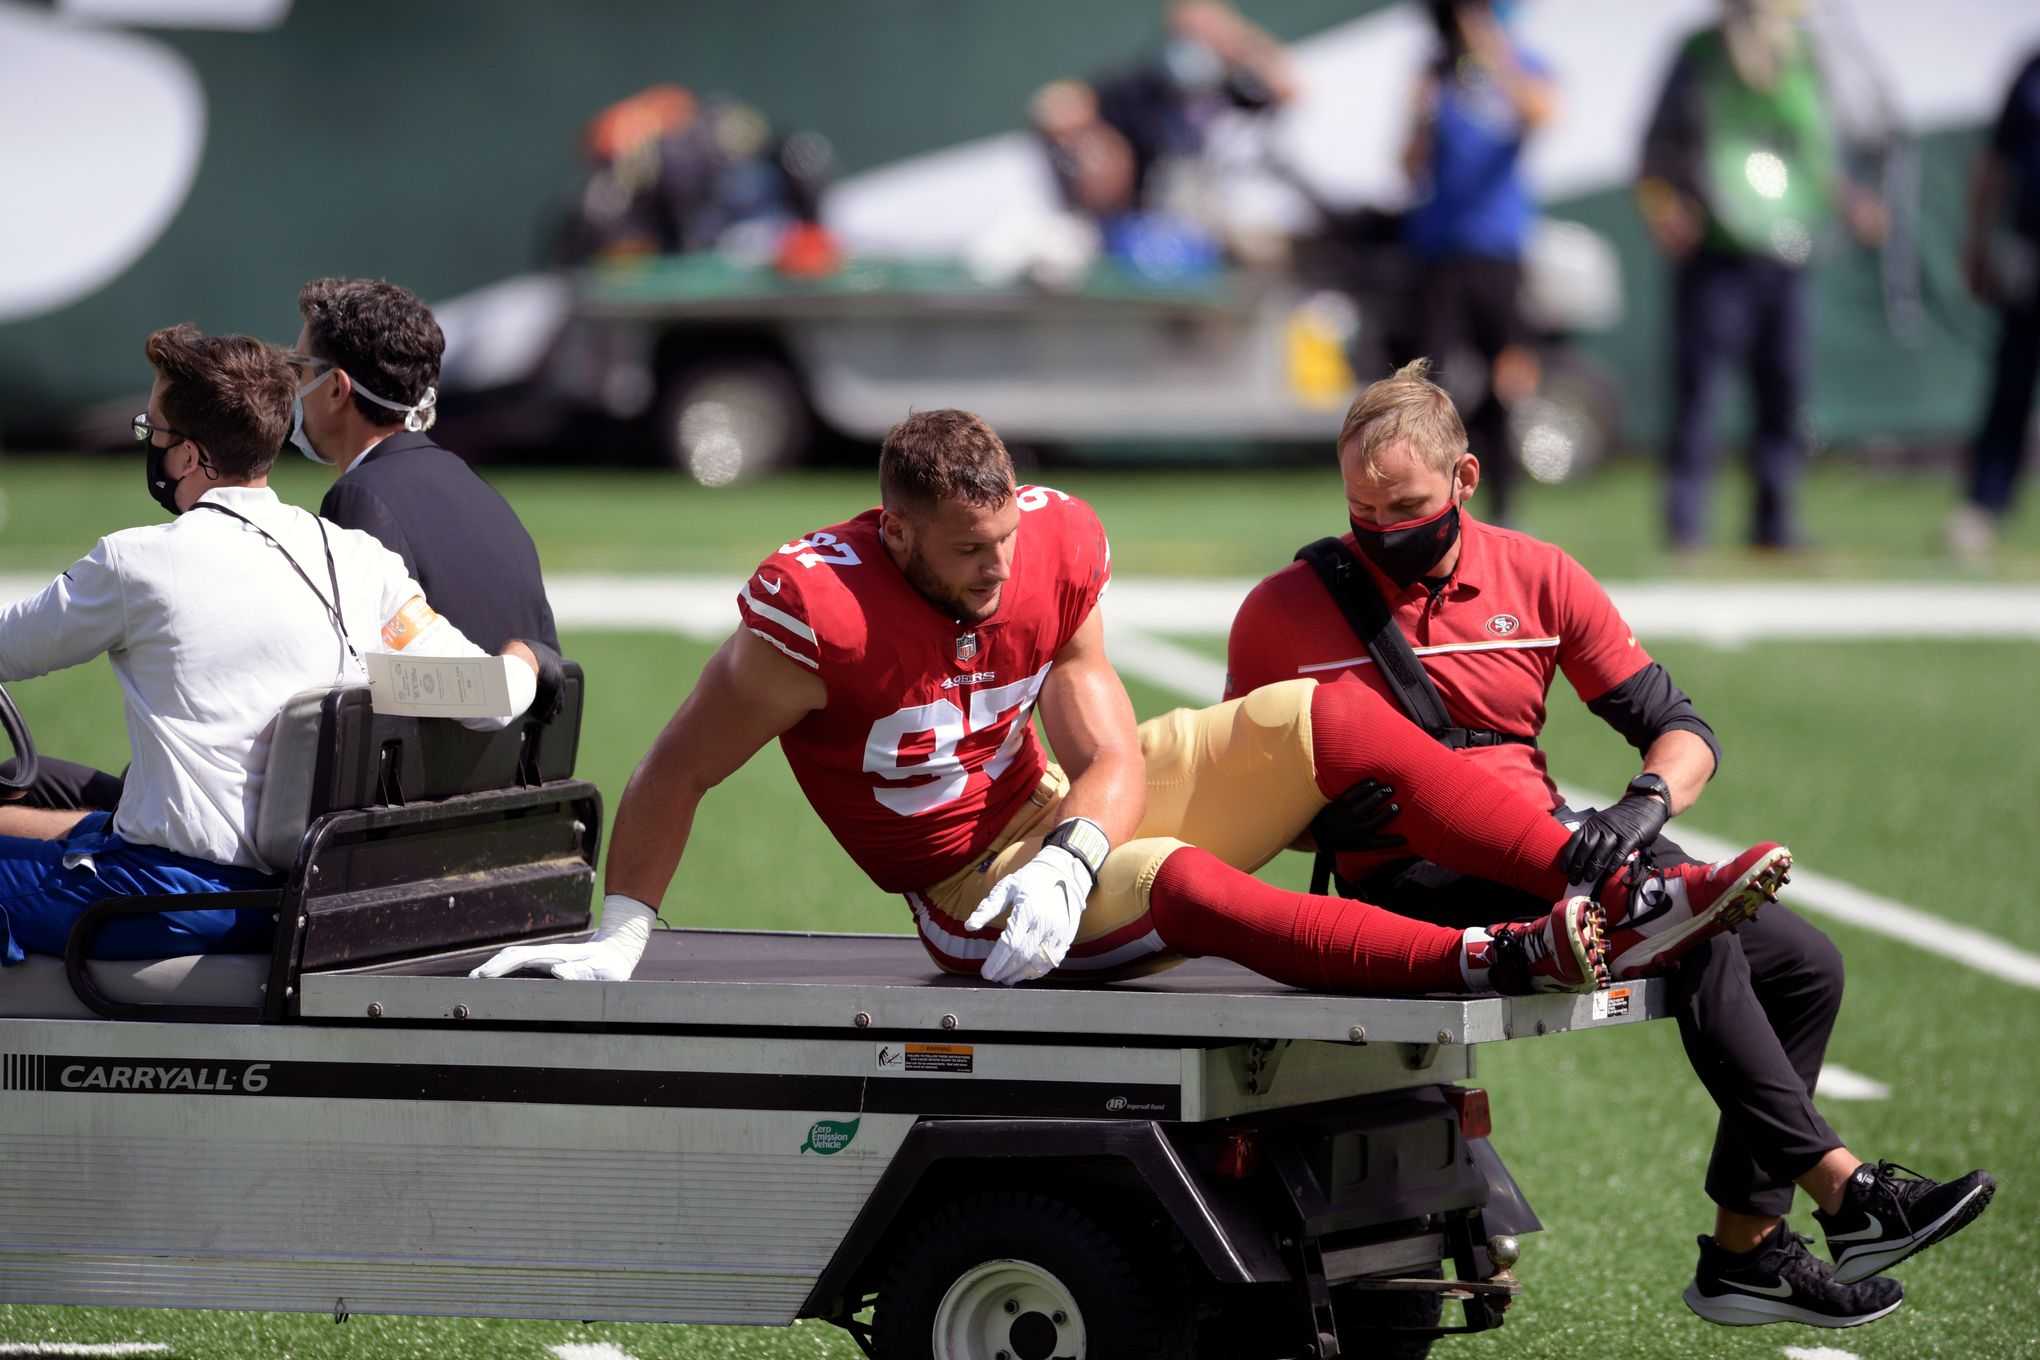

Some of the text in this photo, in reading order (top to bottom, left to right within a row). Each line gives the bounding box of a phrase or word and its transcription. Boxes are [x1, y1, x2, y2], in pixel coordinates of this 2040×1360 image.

[778, 532, 863, 569] 97
[940, 671, 996, 690] 49ERS
[863, 660, 1055, 817] 97
[60, 1063, 271, 1092] CARRYALL 6
[812, 1124, 832, 1133] Zero
[812, 1132, 848, 1141] Emission
[812, 1140, 841, 1149] Vehicle
